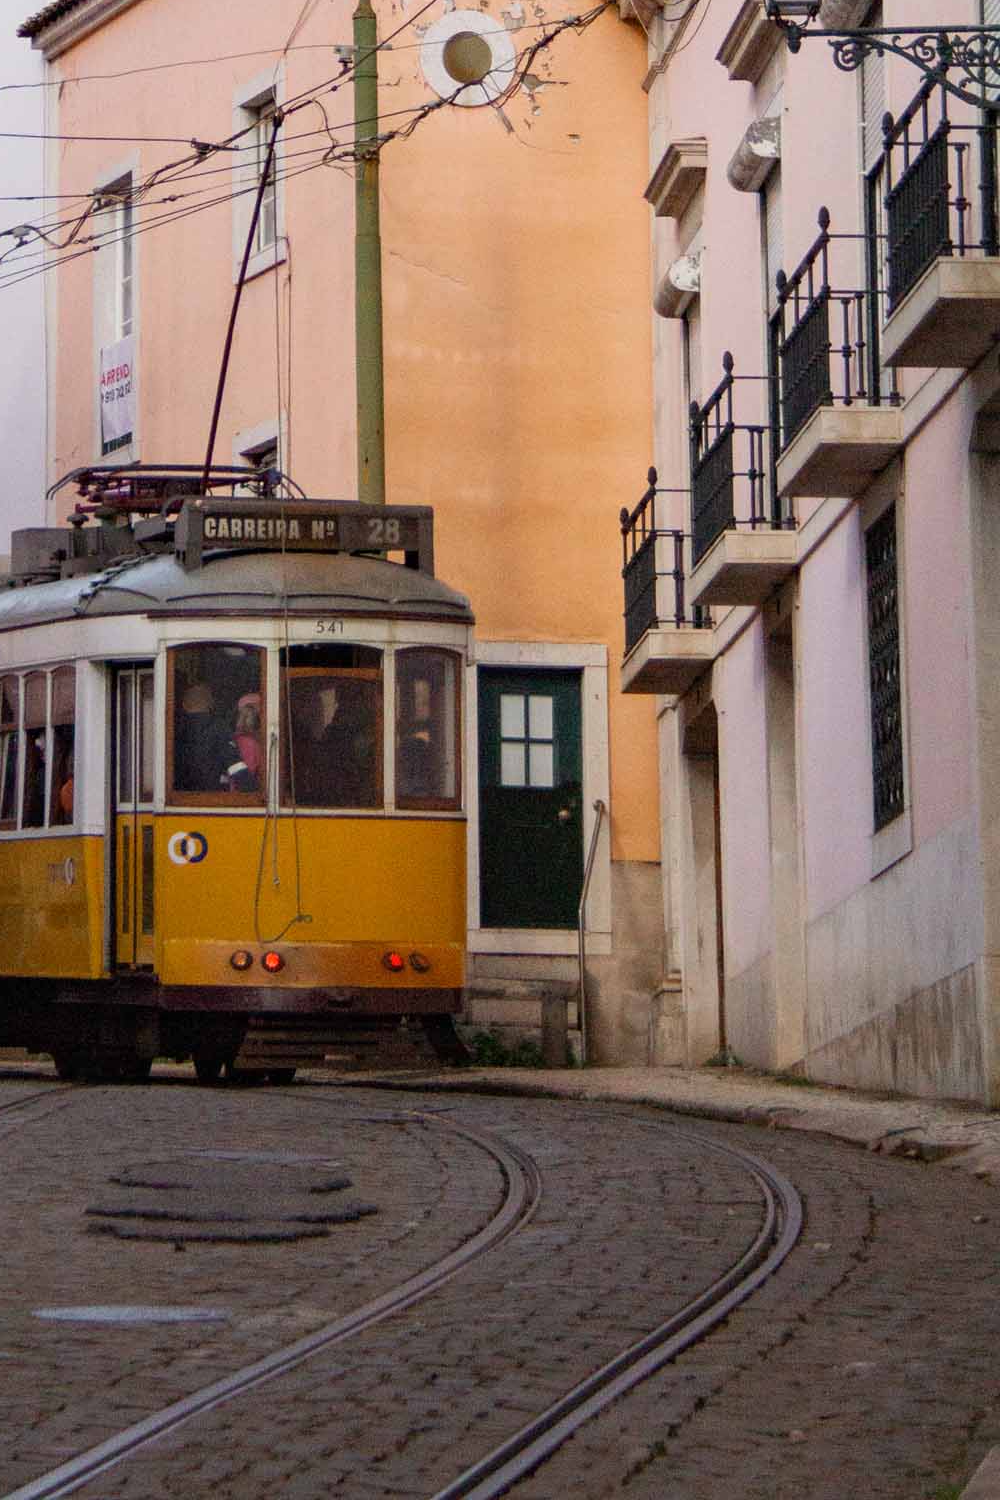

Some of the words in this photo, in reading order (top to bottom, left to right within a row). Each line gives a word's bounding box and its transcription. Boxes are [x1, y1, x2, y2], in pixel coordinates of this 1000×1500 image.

[204, 518, 300, 539] CARREIRA
[367, 519, 400, 543] 28
[316, 620, 344, 634] 541
